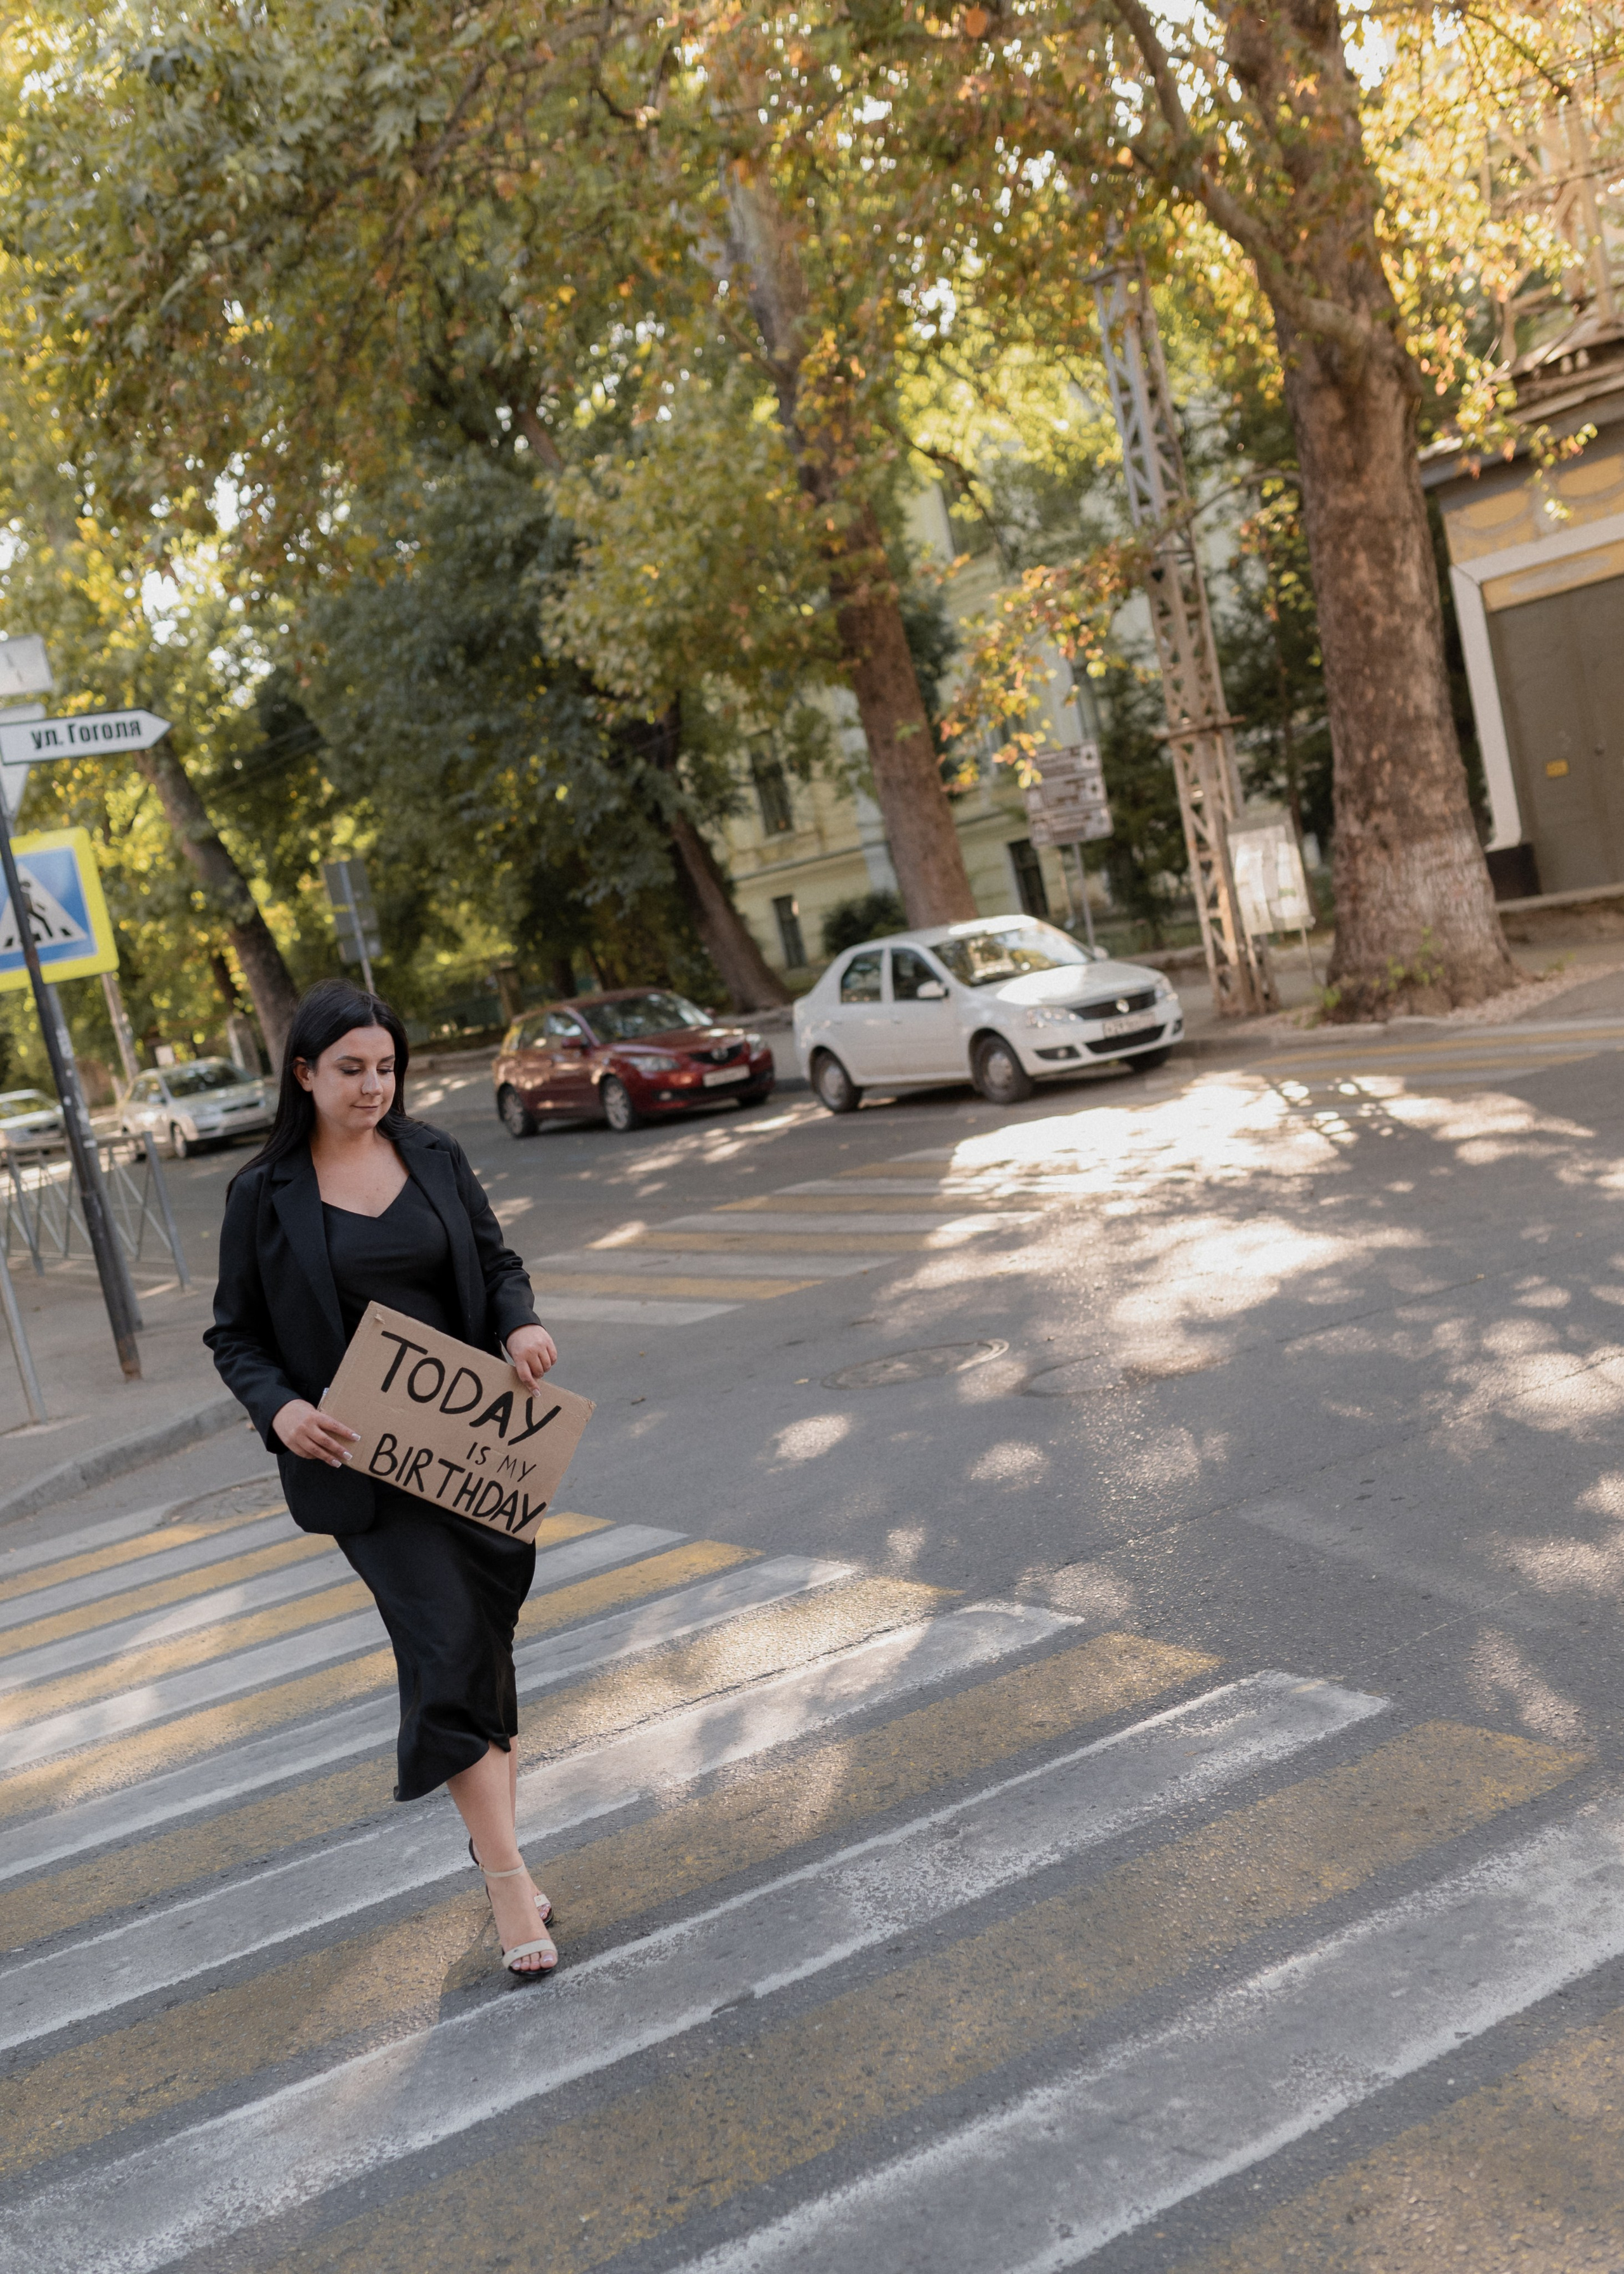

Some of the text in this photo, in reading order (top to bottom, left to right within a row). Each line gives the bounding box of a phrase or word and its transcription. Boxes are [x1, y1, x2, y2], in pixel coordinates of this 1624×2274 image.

[32, 720, 141, 749] ул. Гоголя
[381, 1331, 561, 1446] TODAY
[369, 1433, 547, 1534] BIRTHDAY
[466, 1442, 536, 1482] IS MY
